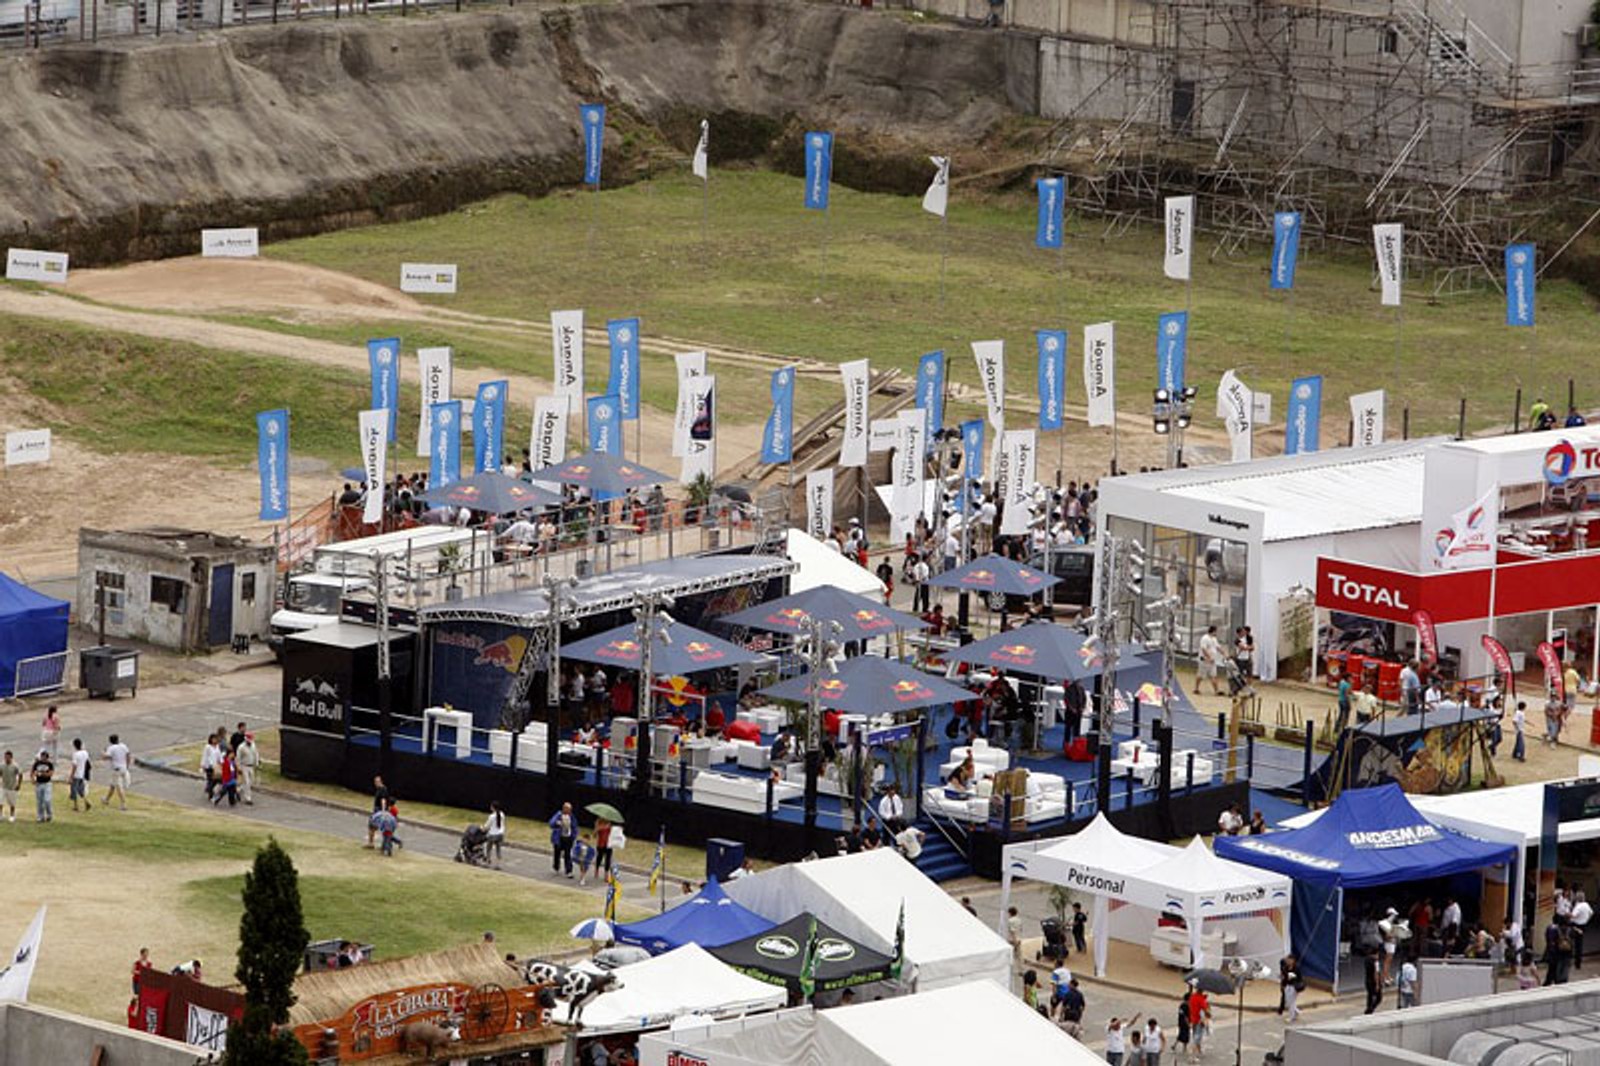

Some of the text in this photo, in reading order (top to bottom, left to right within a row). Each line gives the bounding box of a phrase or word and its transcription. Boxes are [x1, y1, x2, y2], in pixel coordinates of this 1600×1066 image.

[1208, 513, 1249, 530] Volkswagen
[1327, 571, 1409, 610] TOTAL
[289, 696, 343, 721] Red Bull
[1349, 825, 1438, 846] ANDESMAR
[1067, 867, 1126, 895] Personal
[375, 1003, 395, 1023] LA
[397, 989, 449, 1017] CHACRA
